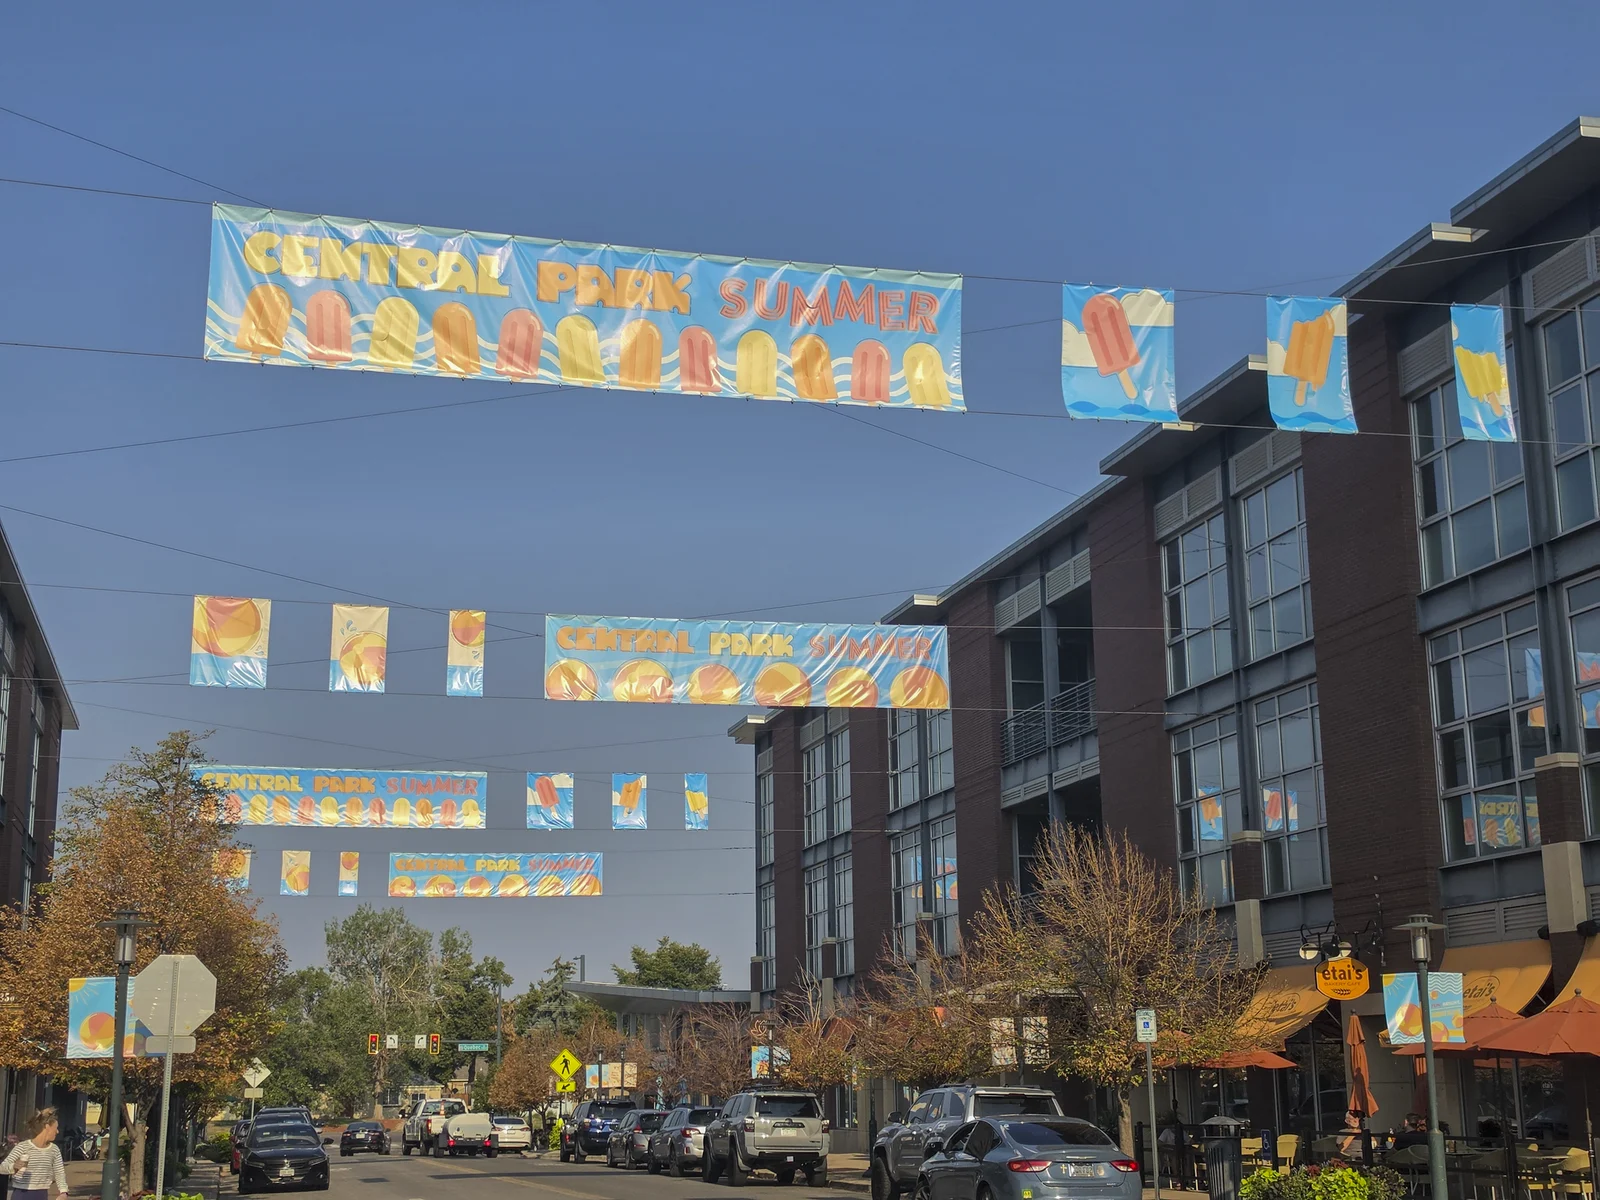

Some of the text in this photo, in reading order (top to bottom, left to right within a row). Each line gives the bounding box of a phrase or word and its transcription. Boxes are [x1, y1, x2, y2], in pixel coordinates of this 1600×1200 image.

[243, 230, 941, 335] CENTRAL PARK SUMMER
[556, 625, 932, 660] CENTRAL PARK SUMMER
[313, 776, 376, 793] PARK
[386, 776, 479, 796] SUMMER
[395, 857, 595, 872] CENTRAL PARK SUMMER
[1322, 964, 1363, 980] etai's
